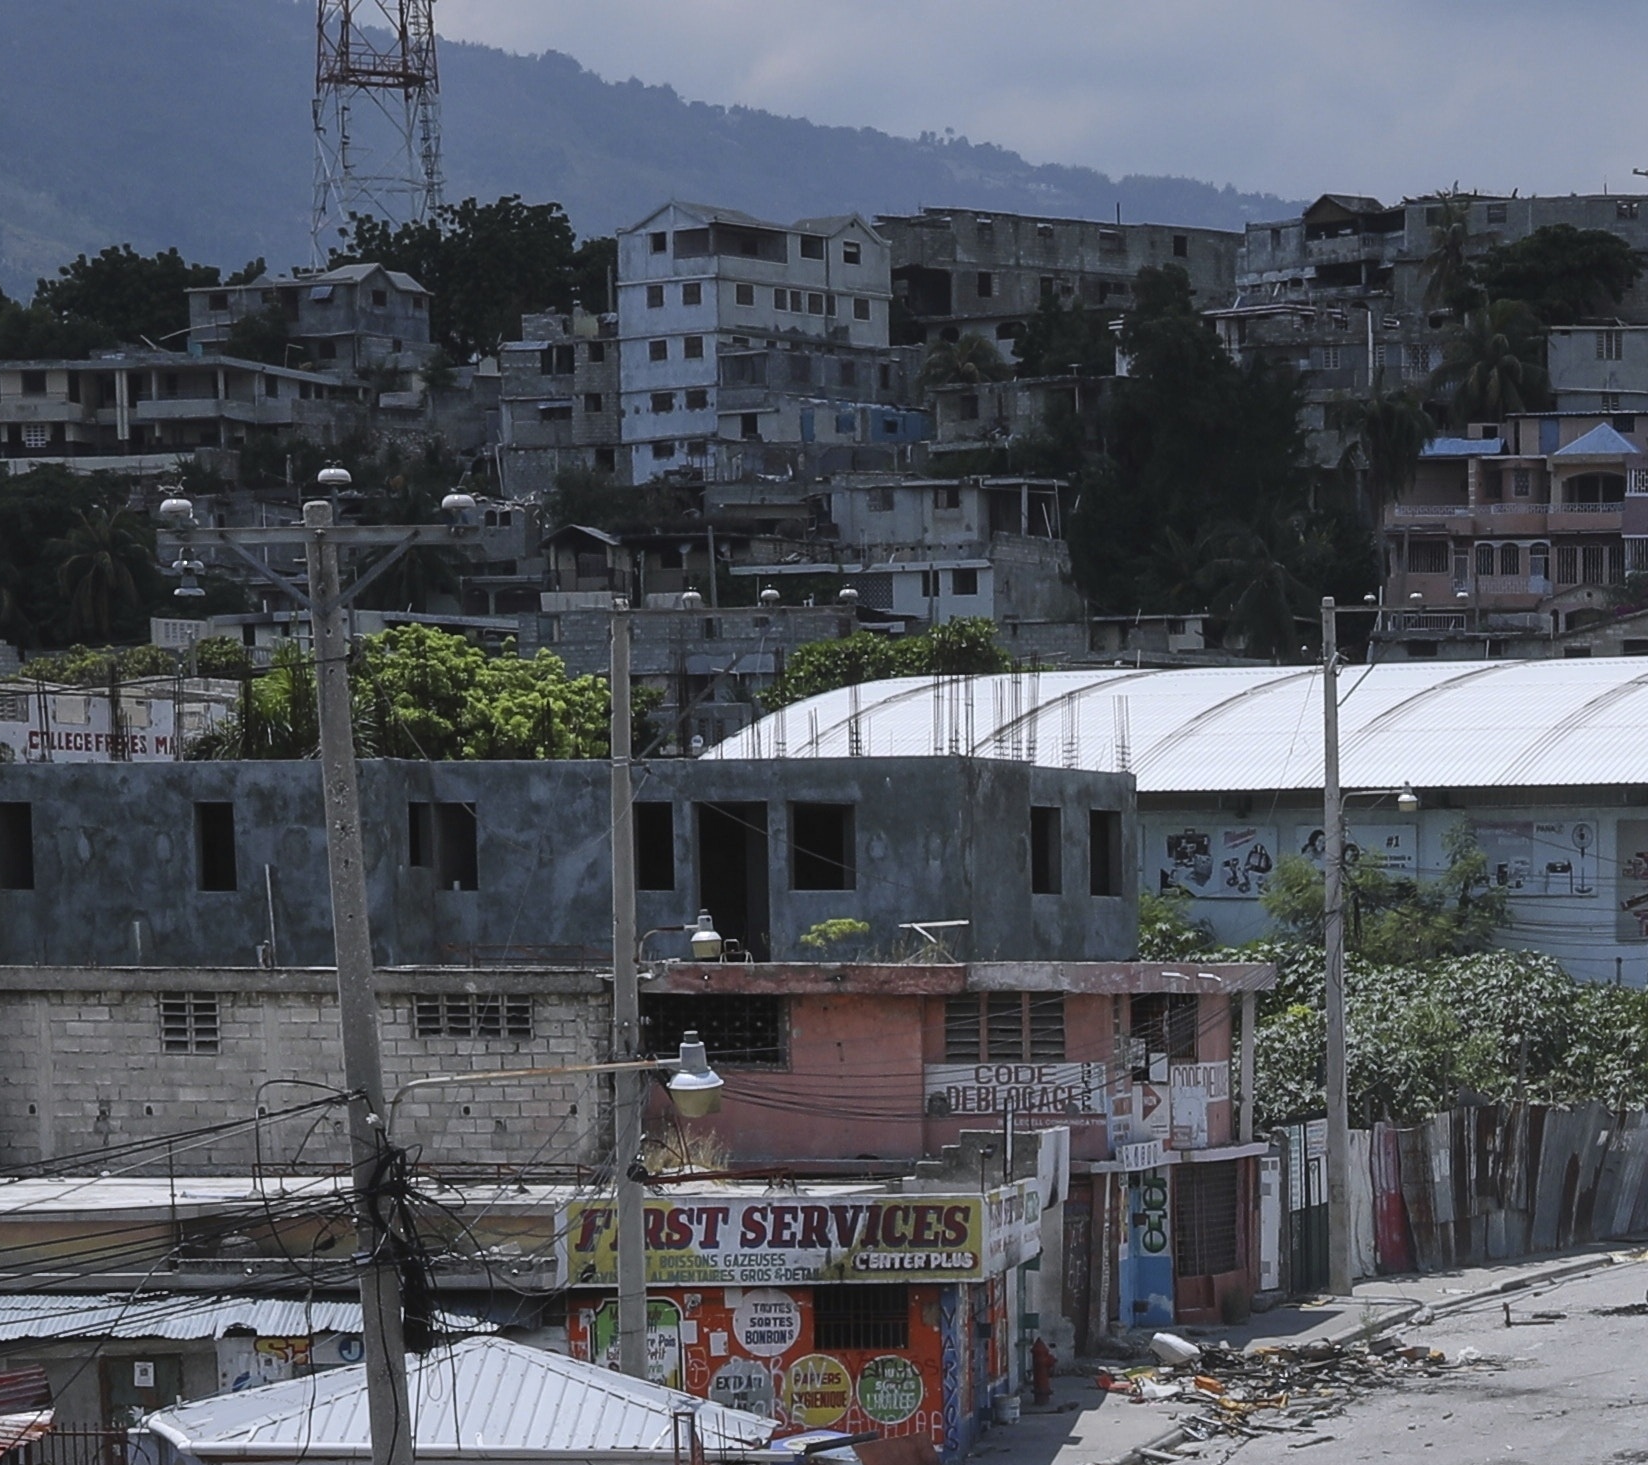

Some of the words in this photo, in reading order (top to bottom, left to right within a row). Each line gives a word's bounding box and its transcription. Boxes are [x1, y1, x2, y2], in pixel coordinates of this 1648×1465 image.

[29, 731, 92, 750] COLLEGE
[974, 1065, 1057, 1085] CODE
[574, 1206, 729, 1251] FRST
[739, 1204, 971, 1250] SERVICES
[660, 1253, 718, 1269] BOISSONS
[723, 1252, 786, 1268] GAZEUSES
[855, 1251, 926, 1271] CENTER
[929, 1251, 975, 1270] PLUS
[651, 1269, 735, 1283] ALIMENTAIRES
[739, 1268, 772, 1282] GROS
[752, 1302, 792, 1315] TOUTES
[749, 1317, 794, 1327] SORTES
[744, 1328, 794, 1345] BONBONS
